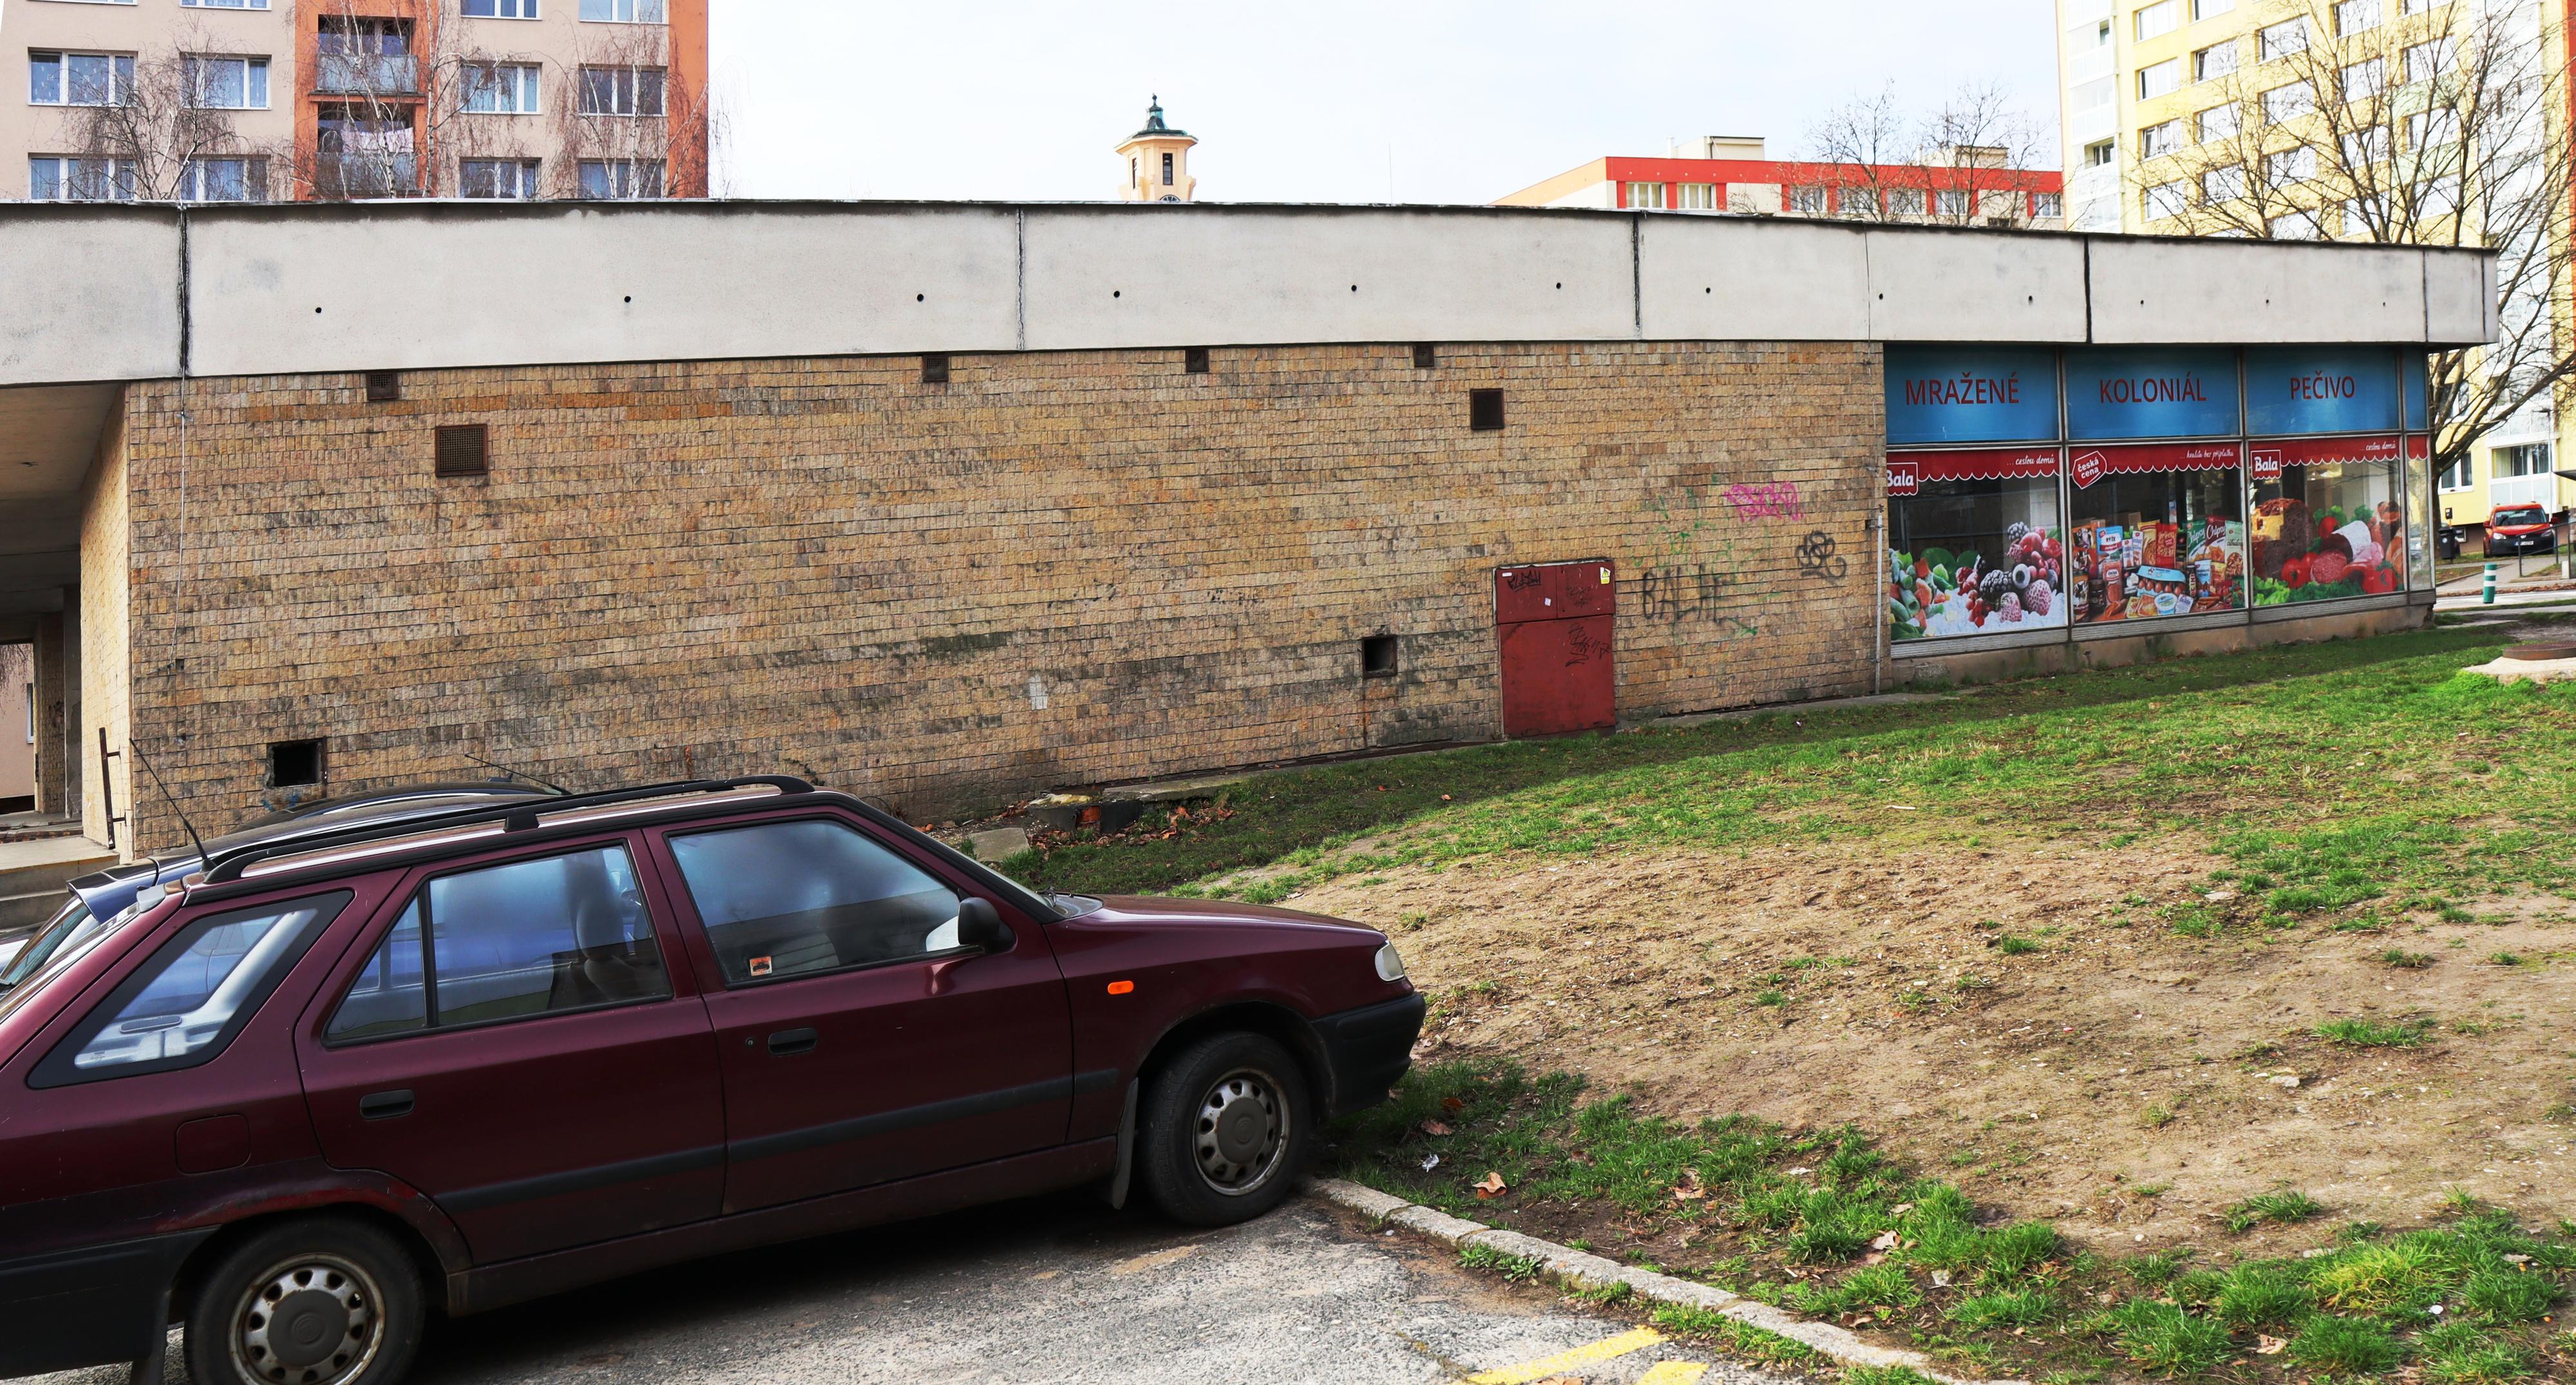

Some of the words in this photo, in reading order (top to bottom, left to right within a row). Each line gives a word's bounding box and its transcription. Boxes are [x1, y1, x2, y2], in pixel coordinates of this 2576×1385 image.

[1906, 372, 2020, 405] MRAŽENÉ
[2099, 371, 2206, 403] KOLONIÁL
[2290, 371, 2355, 400] PEČIVO
[2036, 453, 2056, 464] domů
[2078, 457, 2099, 472] česká
[2254, 456, 2278, 472] Bala
[2081, 467, 2099, 479] cena
